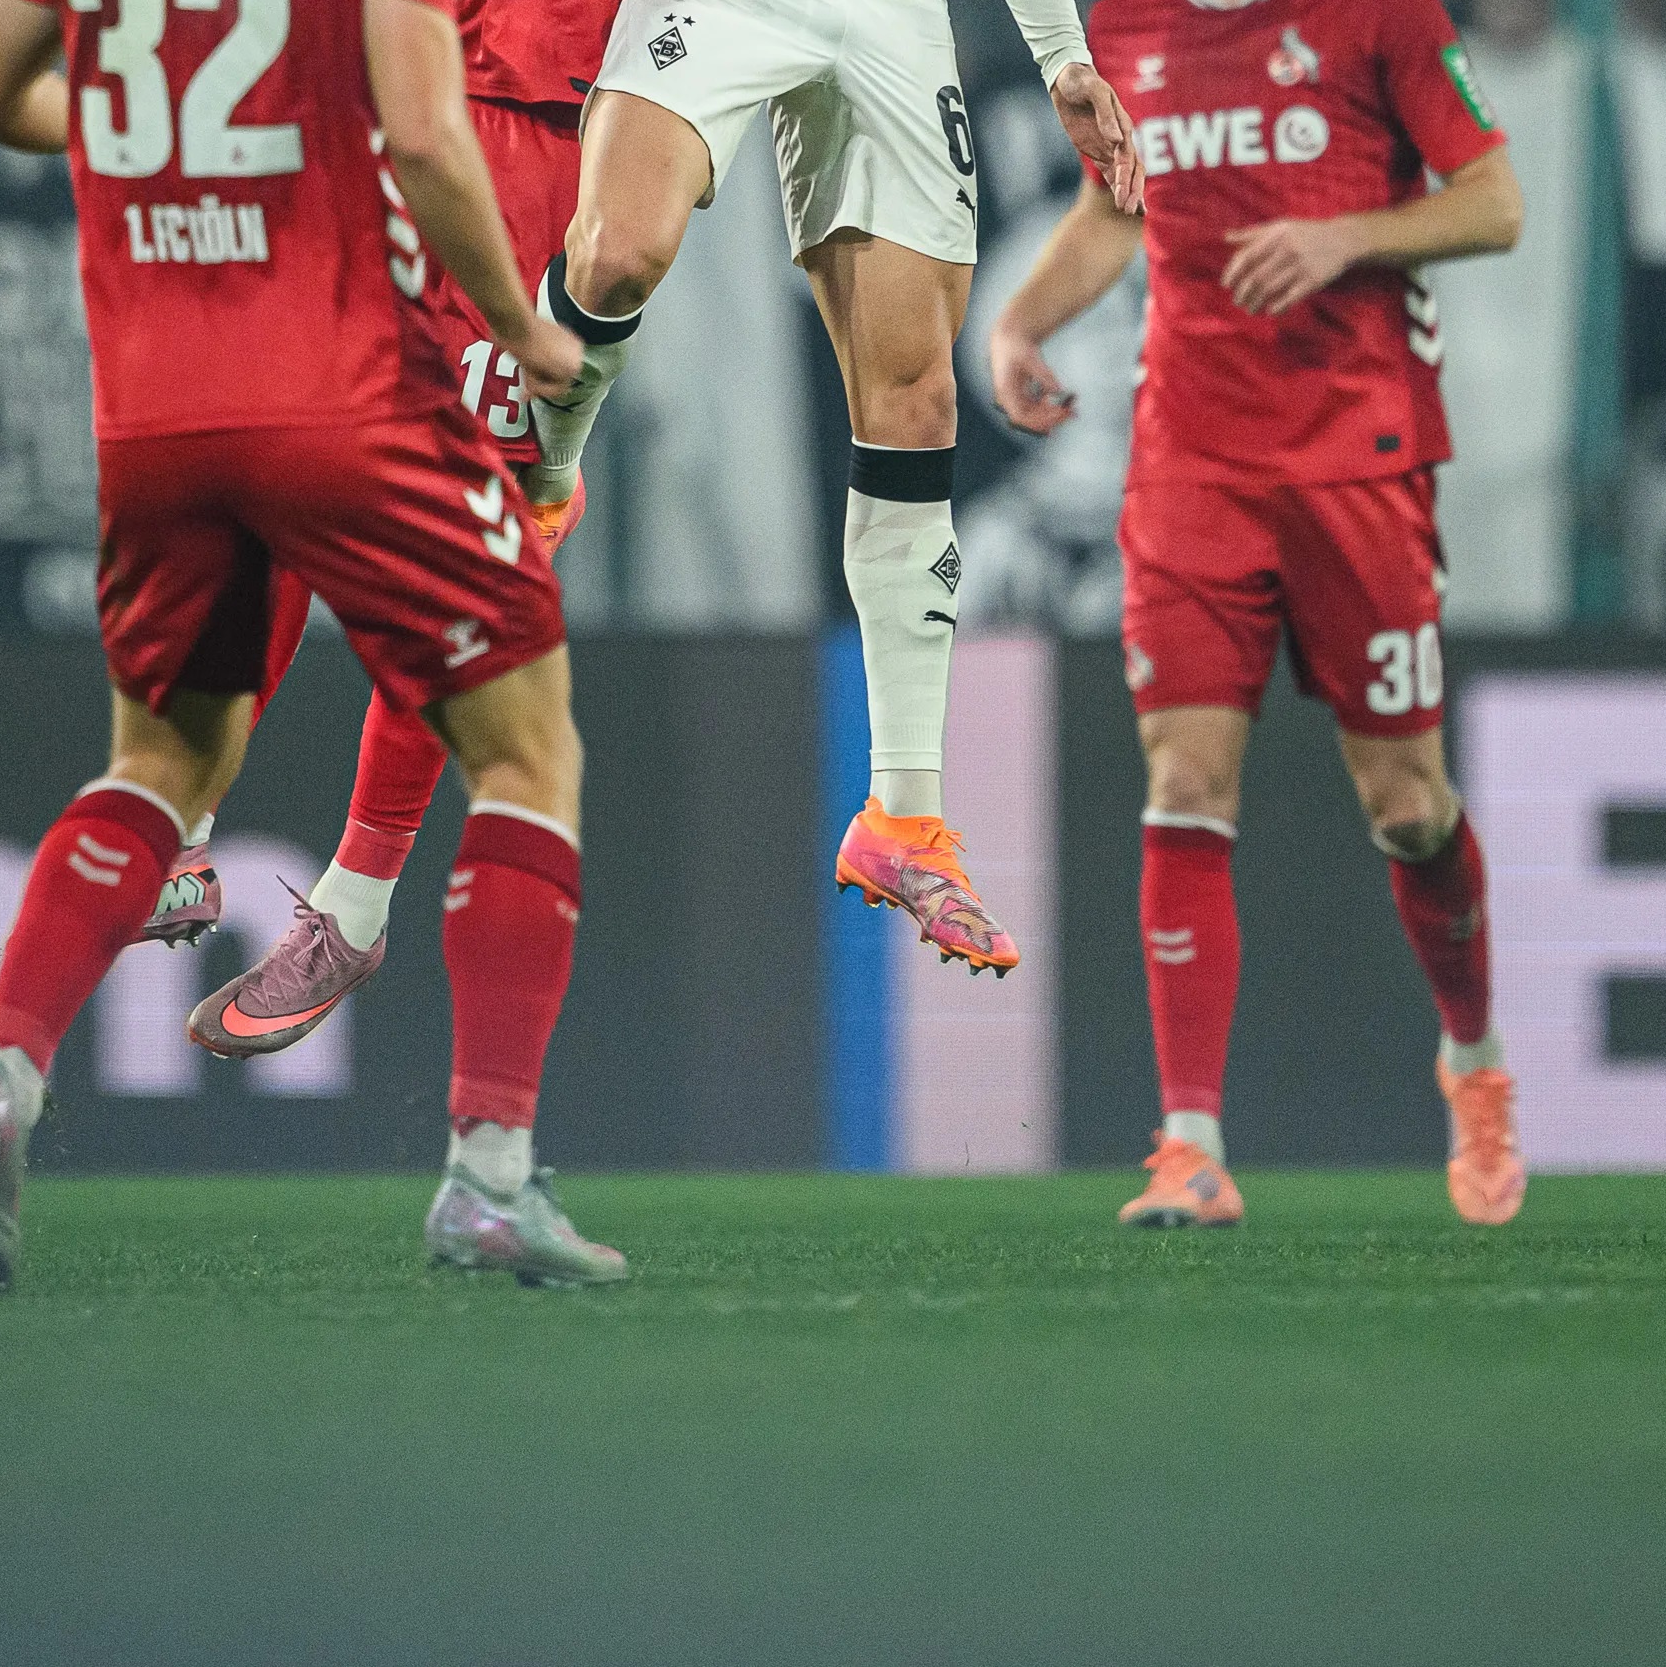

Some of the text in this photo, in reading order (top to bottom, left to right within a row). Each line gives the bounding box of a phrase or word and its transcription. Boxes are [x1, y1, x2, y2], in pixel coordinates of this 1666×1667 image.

[937, 86, 975, 176] 6
[1132, 108, 1269, 177] EWE
[460, 339, 531, 438] 13
[1366, 623, 1443, 715] 30
